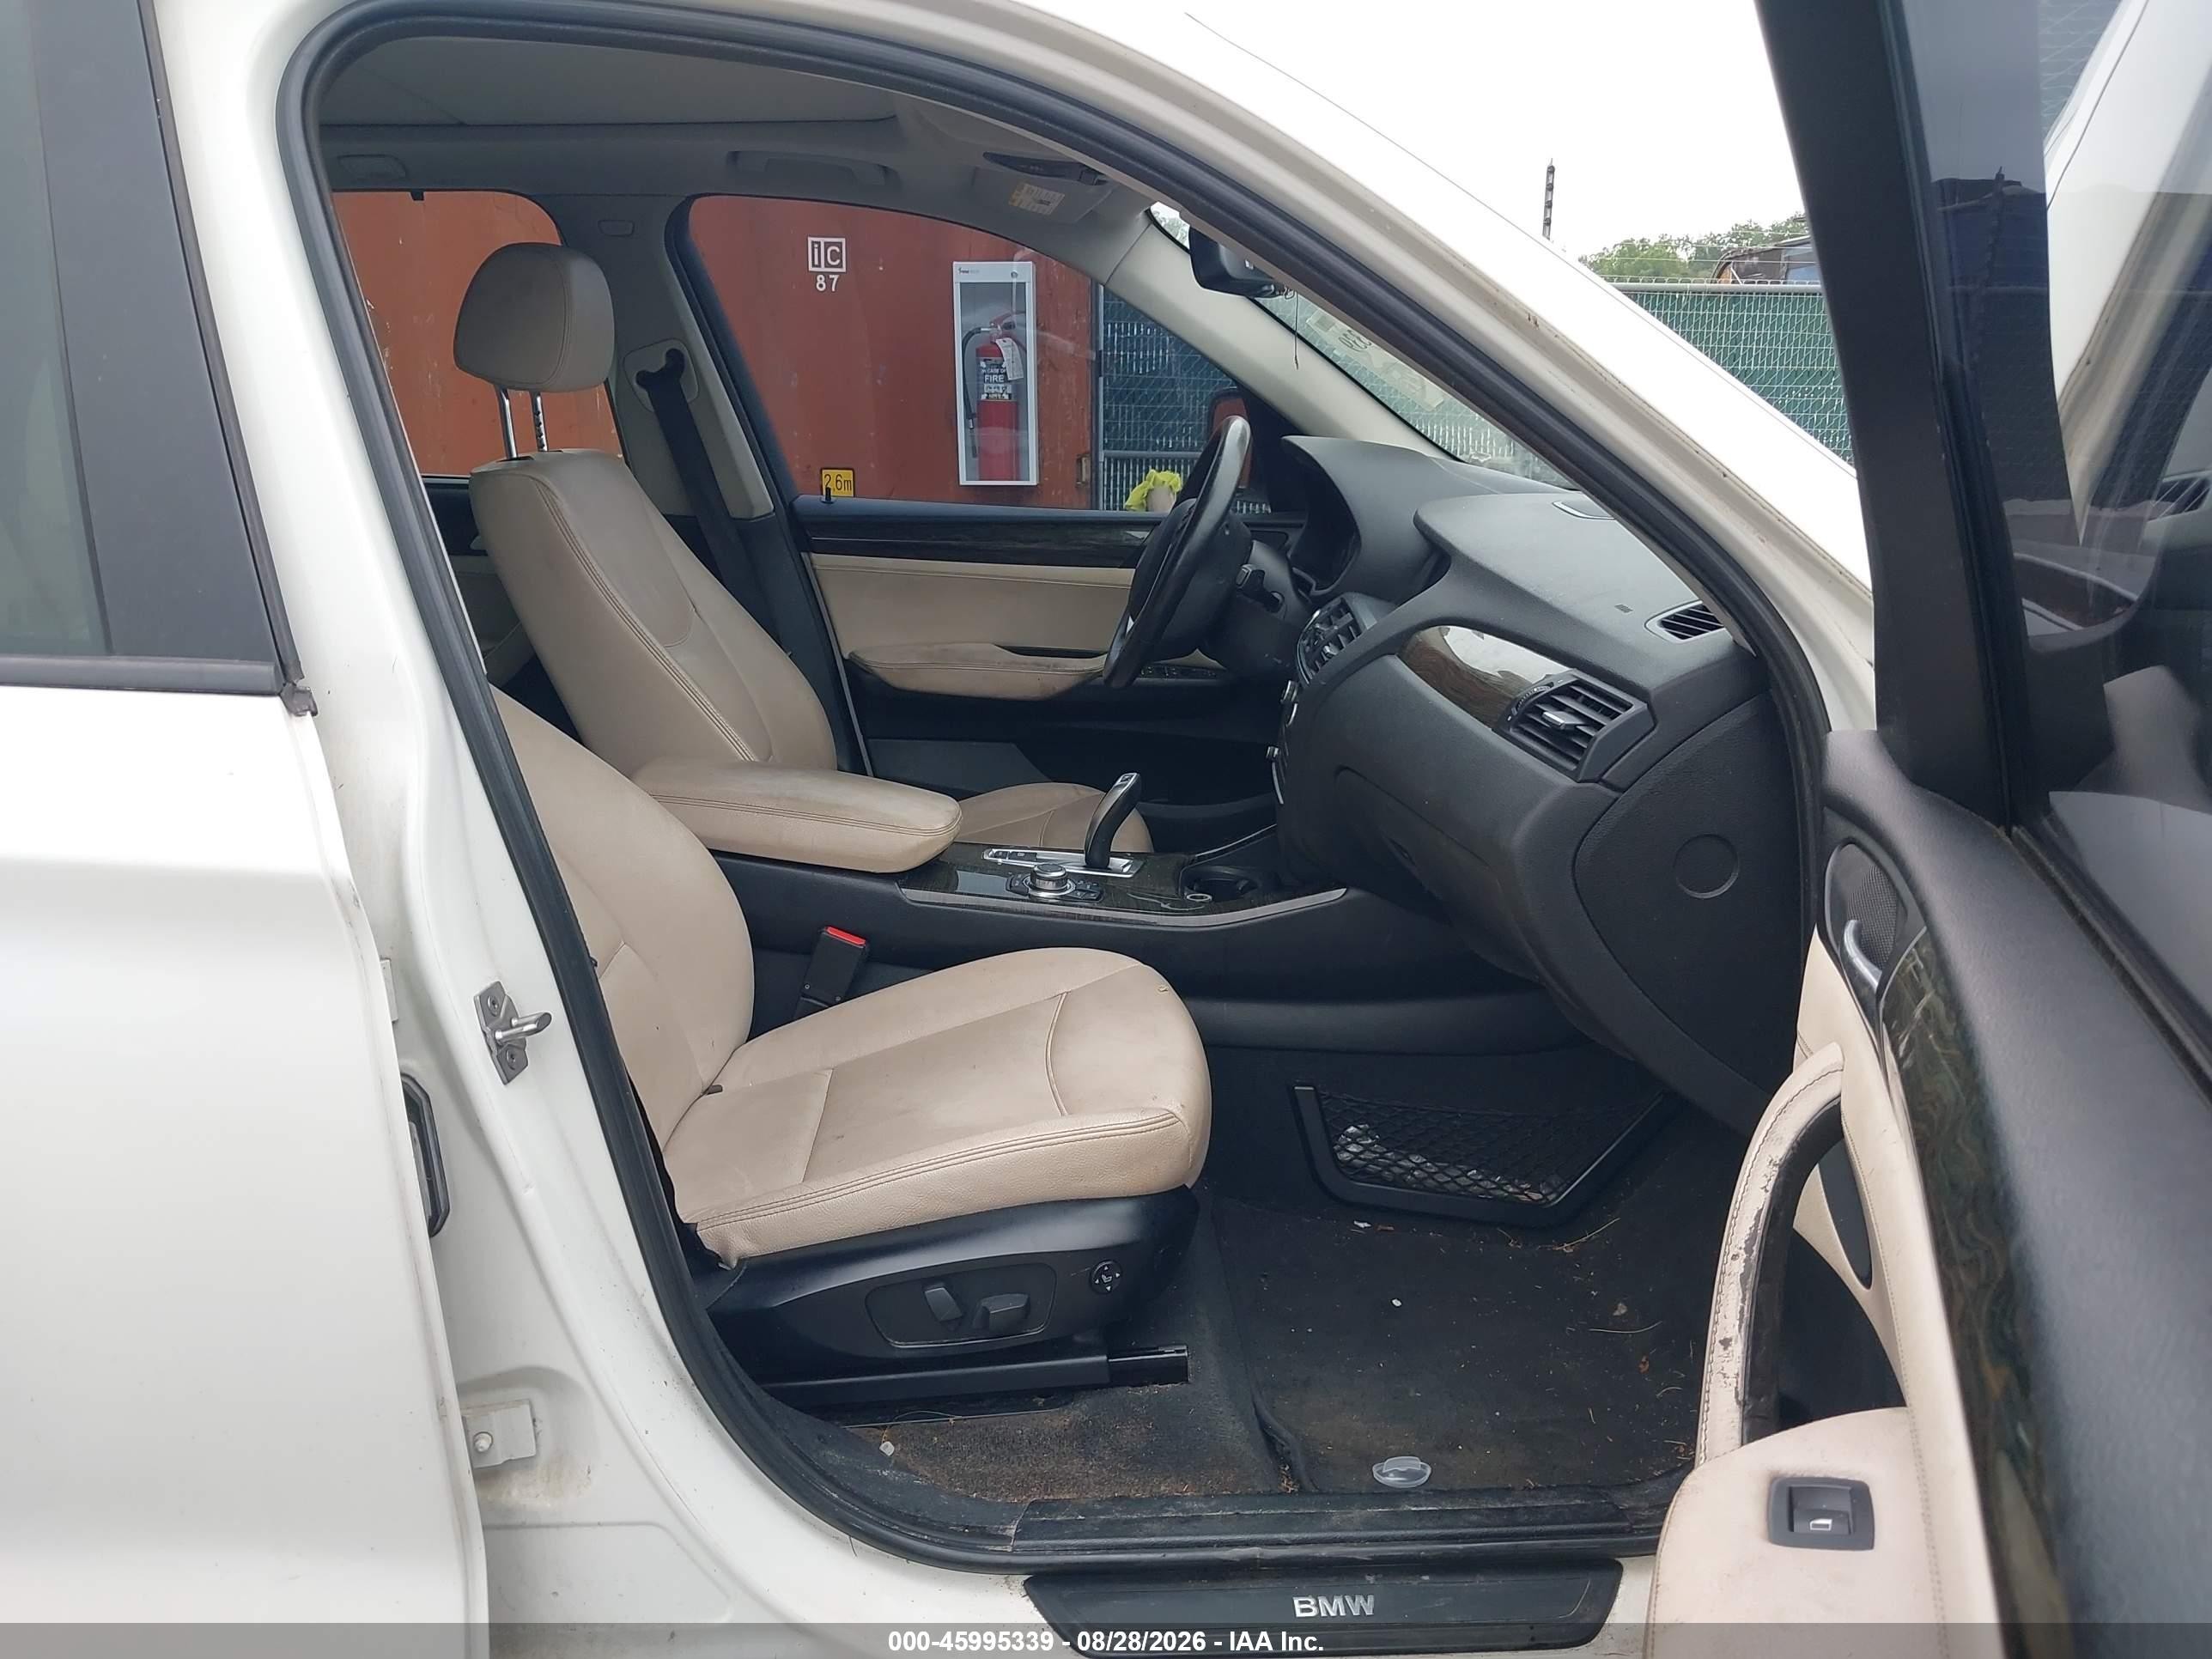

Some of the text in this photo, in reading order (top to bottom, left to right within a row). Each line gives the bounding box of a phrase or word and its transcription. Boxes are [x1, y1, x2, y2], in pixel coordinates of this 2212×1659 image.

[816, 274, 840, 292] 87
[984, 374, 1004, 383] FIRE
[1292, 1595, 1375, 1617] BMW
